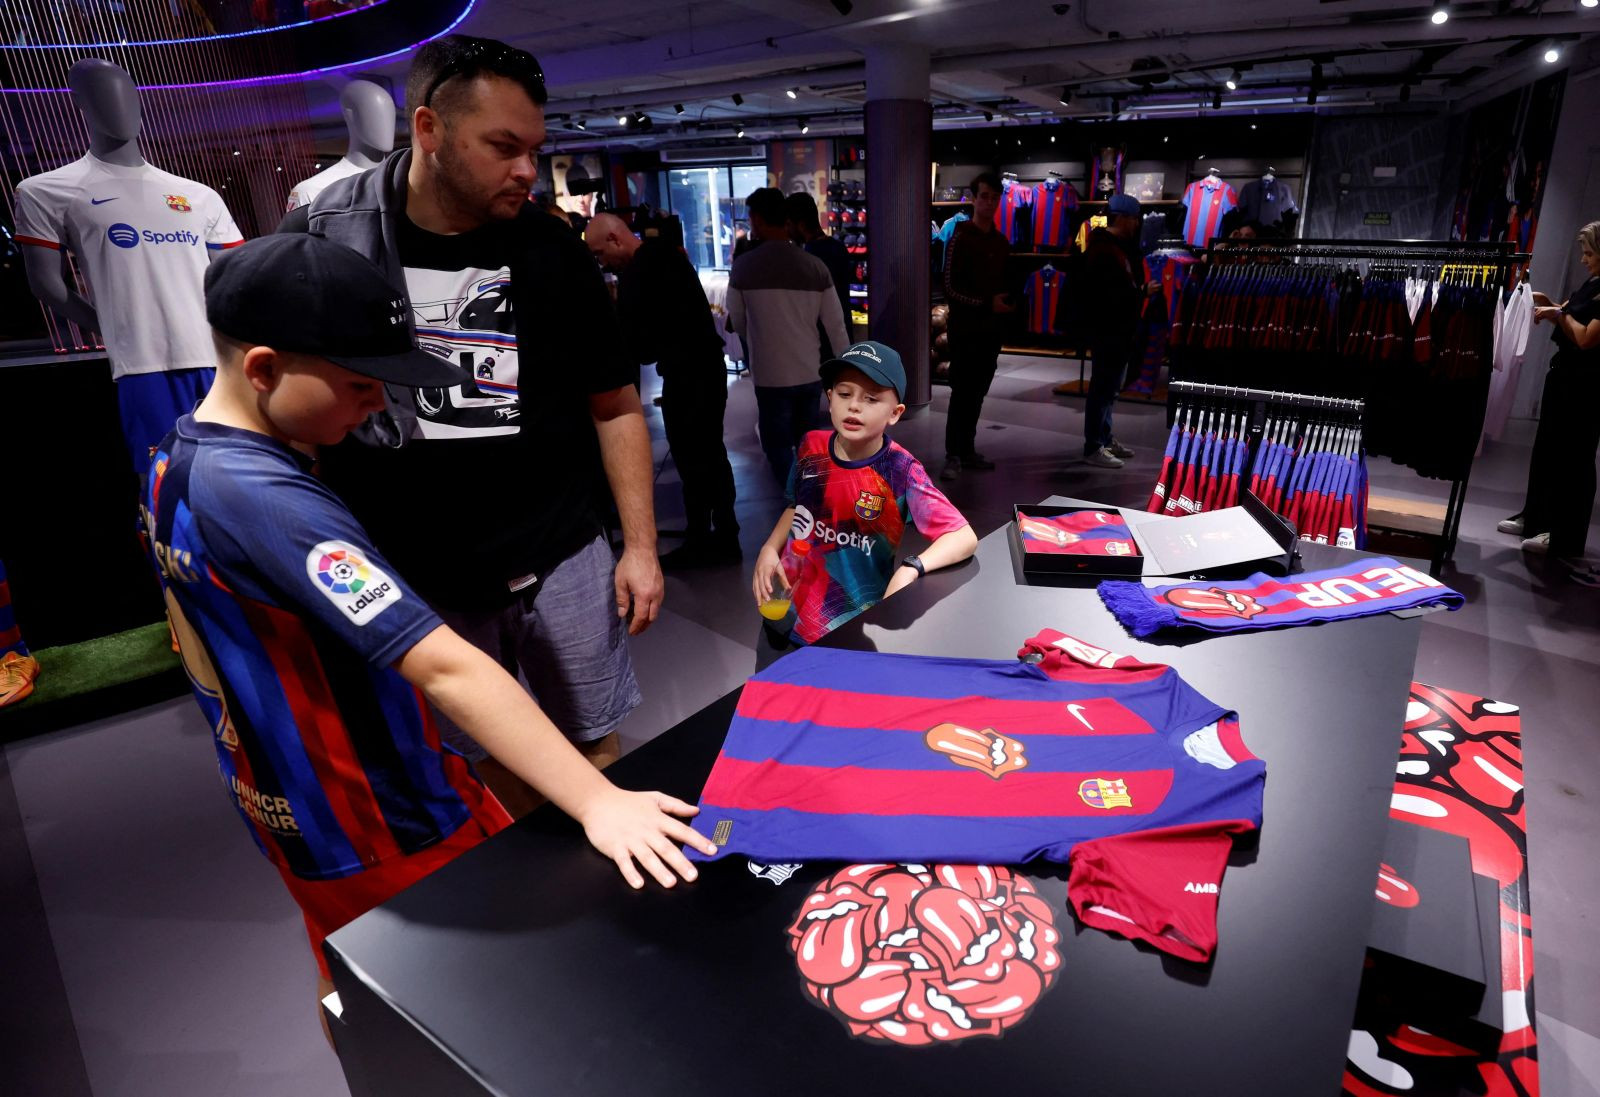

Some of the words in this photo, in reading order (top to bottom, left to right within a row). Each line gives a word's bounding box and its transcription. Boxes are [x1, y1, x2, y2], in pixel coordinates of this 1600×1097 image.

[142, 230, 199, 246] Spotify
[814, 522, 877, 557] Spotify
[347, 581, 392, 615] LaLiga
[231, 775, 292, 814] UNHCR
[238, 796, 299, 830] ACNUR
